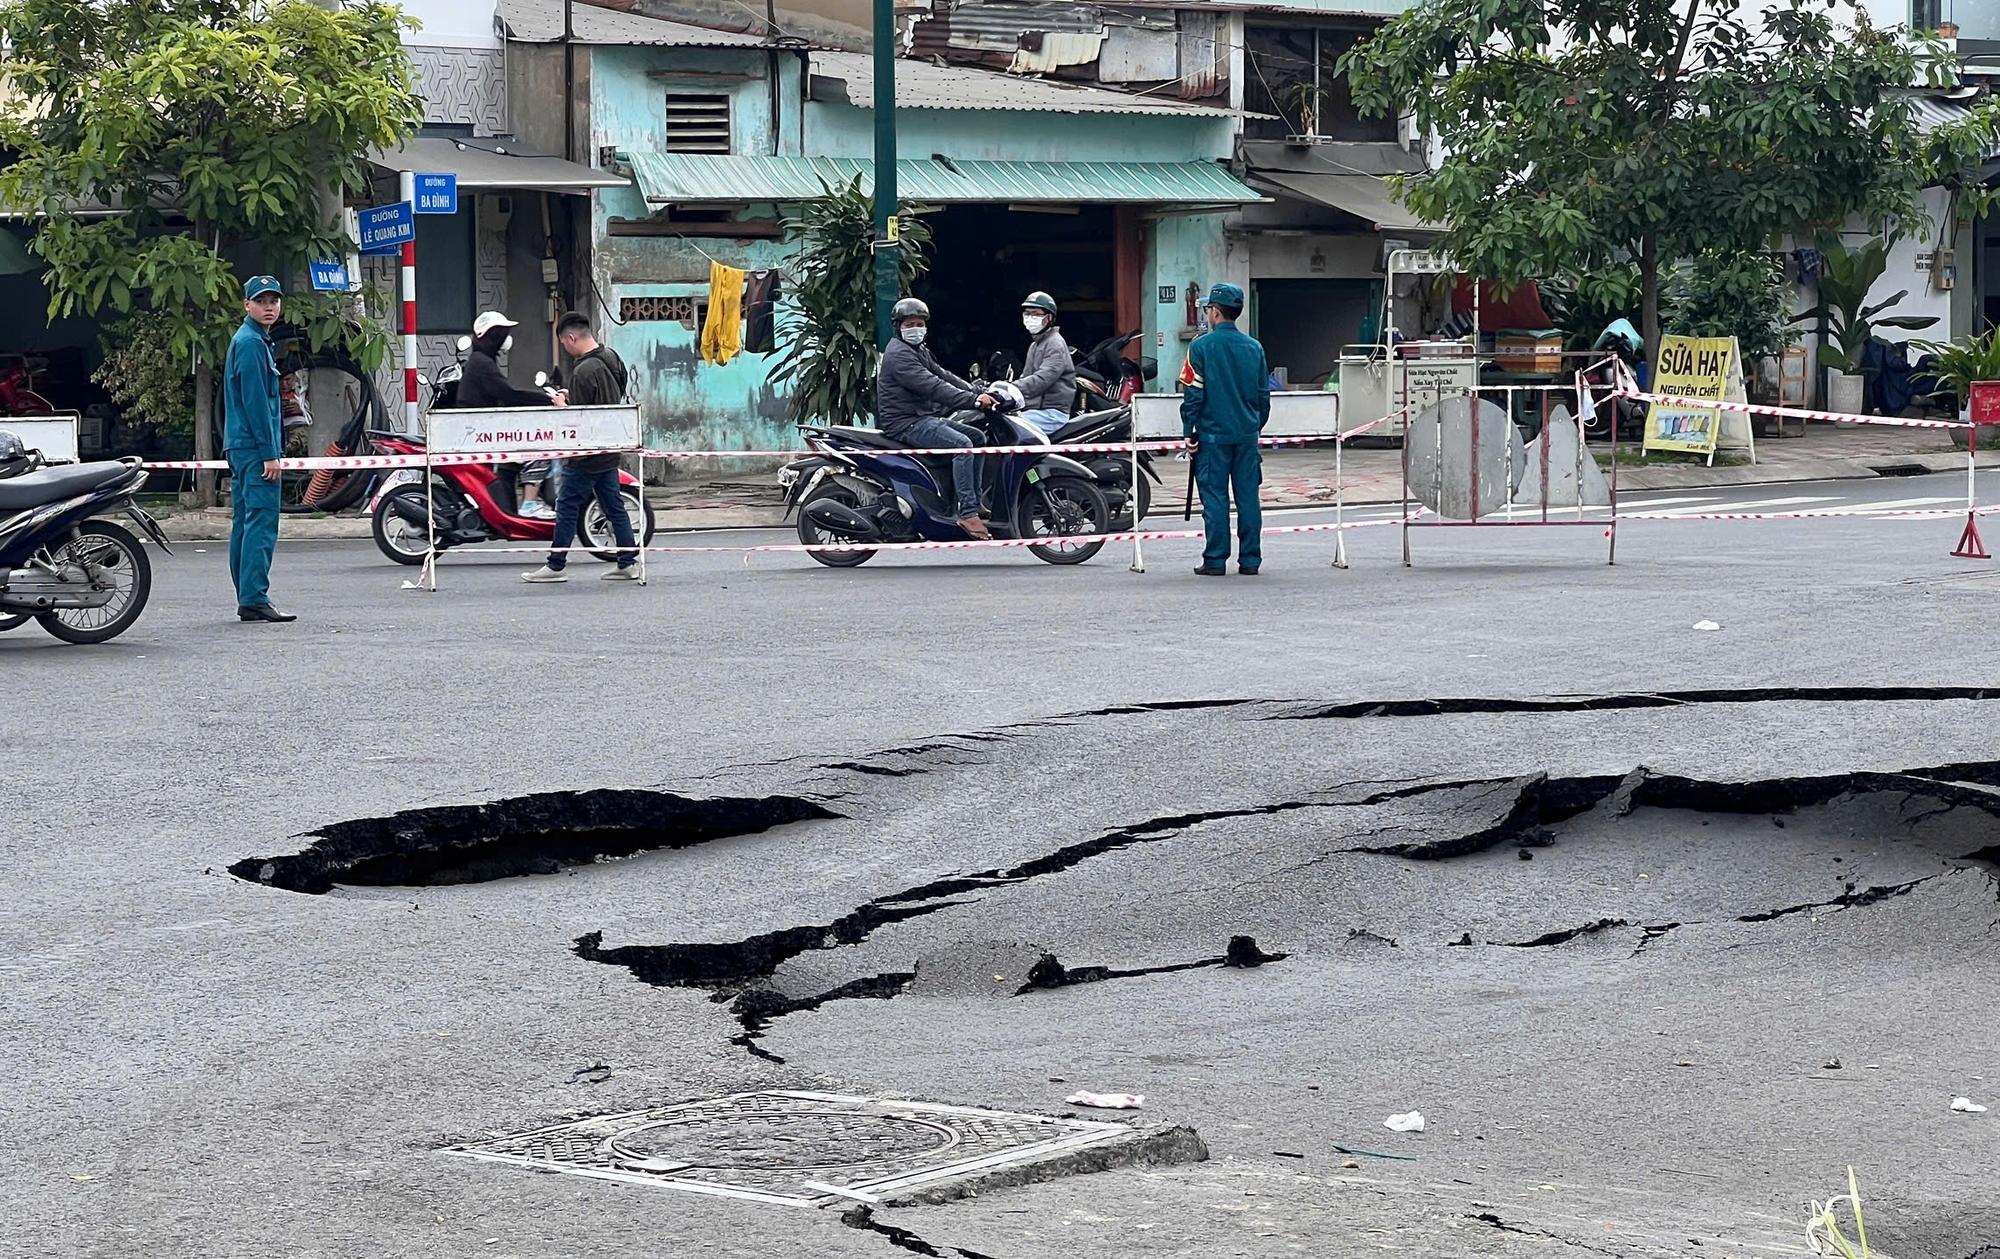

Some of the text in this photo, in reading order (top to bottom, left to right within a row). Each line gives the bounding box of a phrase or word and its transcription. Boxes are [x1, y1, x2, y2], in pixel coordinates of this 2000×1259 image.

[425, 178, 446, 187] ĐƯỜNG
[421, 194, 450, 208] BA ĐÌNH
[371, 209, 399, 223] ĐƯỜNG
[364, 223, 411, 243] LÊ QUANG KIM
[318, 271, 329, 284] BA
[1161, 287, 1174, 298] 415
[1660, 343, 1727, 382] SỮA HẠT
[1660, 384, 1698, 397] NGUYÊN
[1699, 383, 1720, 397] CHẤT
[475, 428, 577, 443] XN PHÚ LÂM 12
